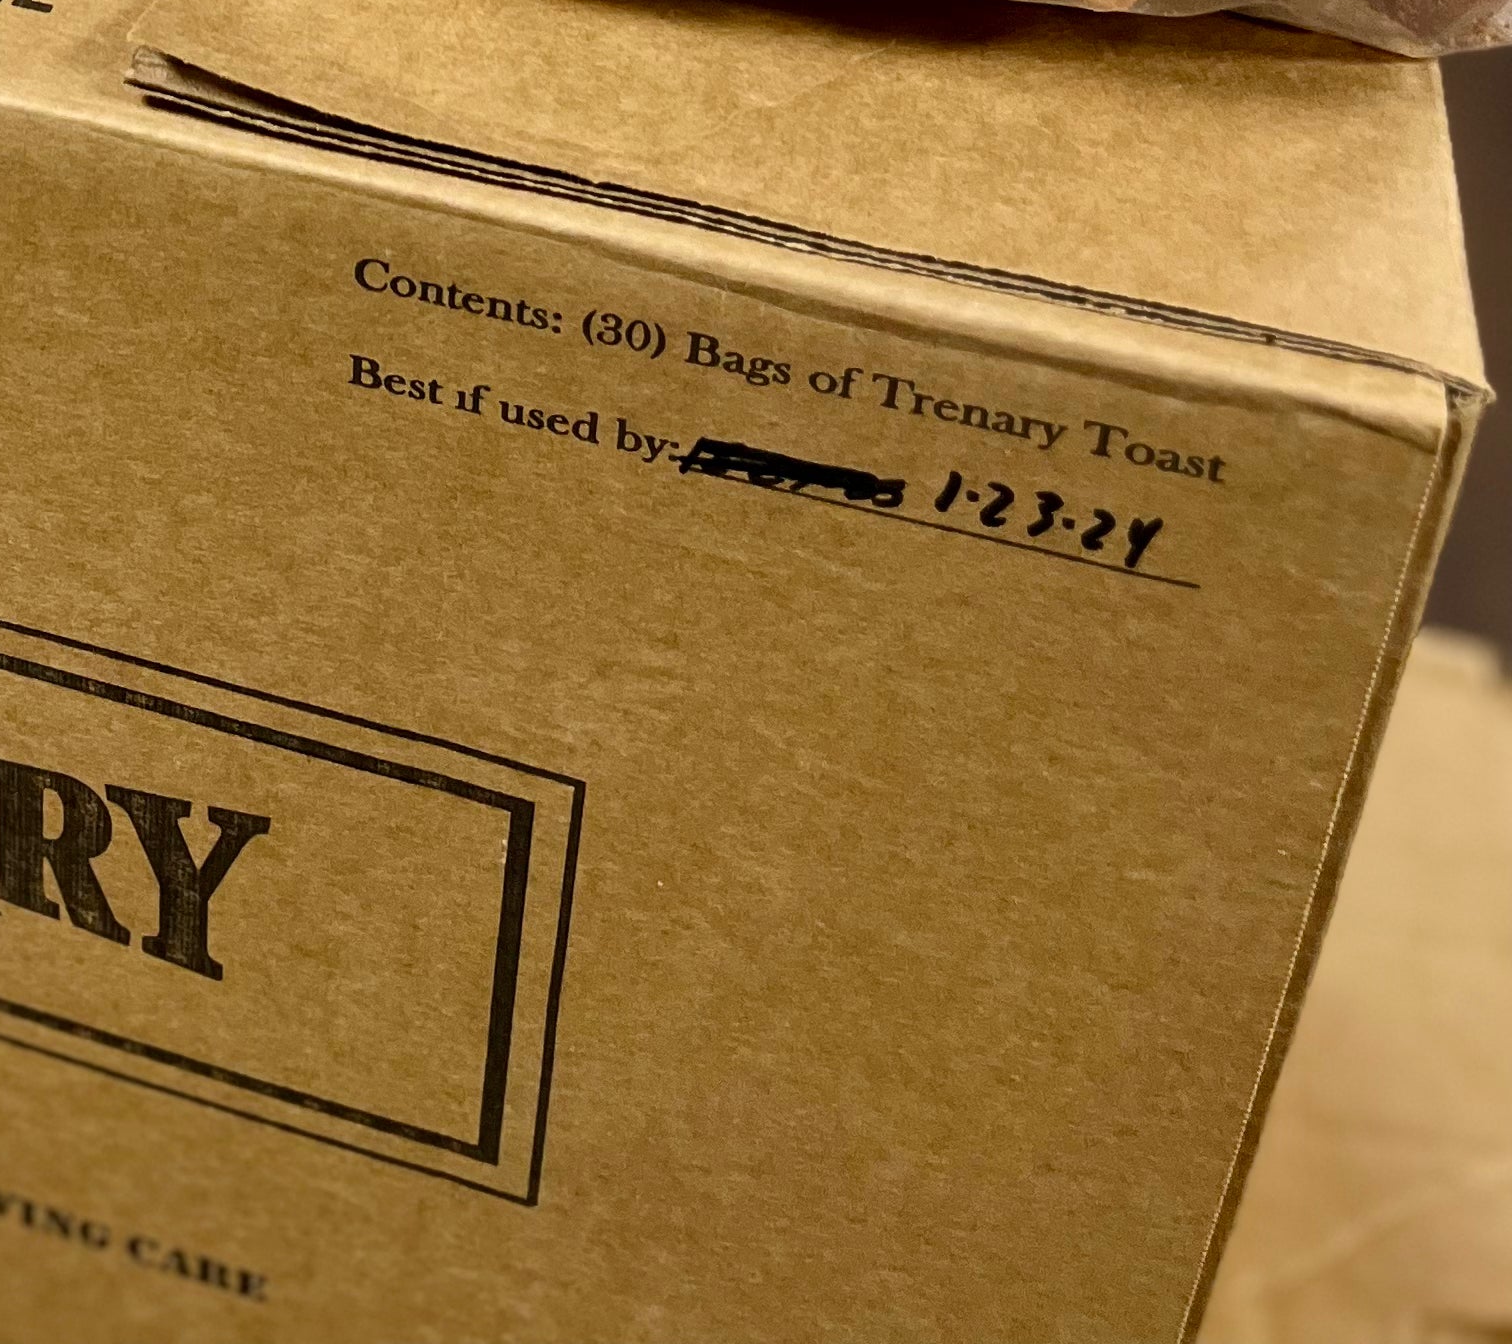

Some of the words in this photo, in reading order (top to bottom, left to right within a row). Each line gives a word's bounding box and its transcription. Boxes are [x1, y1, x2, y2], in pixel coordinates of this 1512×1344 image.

[348, 354, 443, 405] Best
[455, 384, 492, 415] if
[499, 399, 600, 445] used
[616, 417, 681, 463] by:
[354, 258, 563, 334] Contents:
[582, 310, 666, 359] (30)
[684, 331, 792, 387] Bags
[808, 367, 864, 399] of
[872, 372, 1069, 450] Trenary
[1083, 420, 1226, 484] Toast
[125, 1235, 272, 1303] CARE
